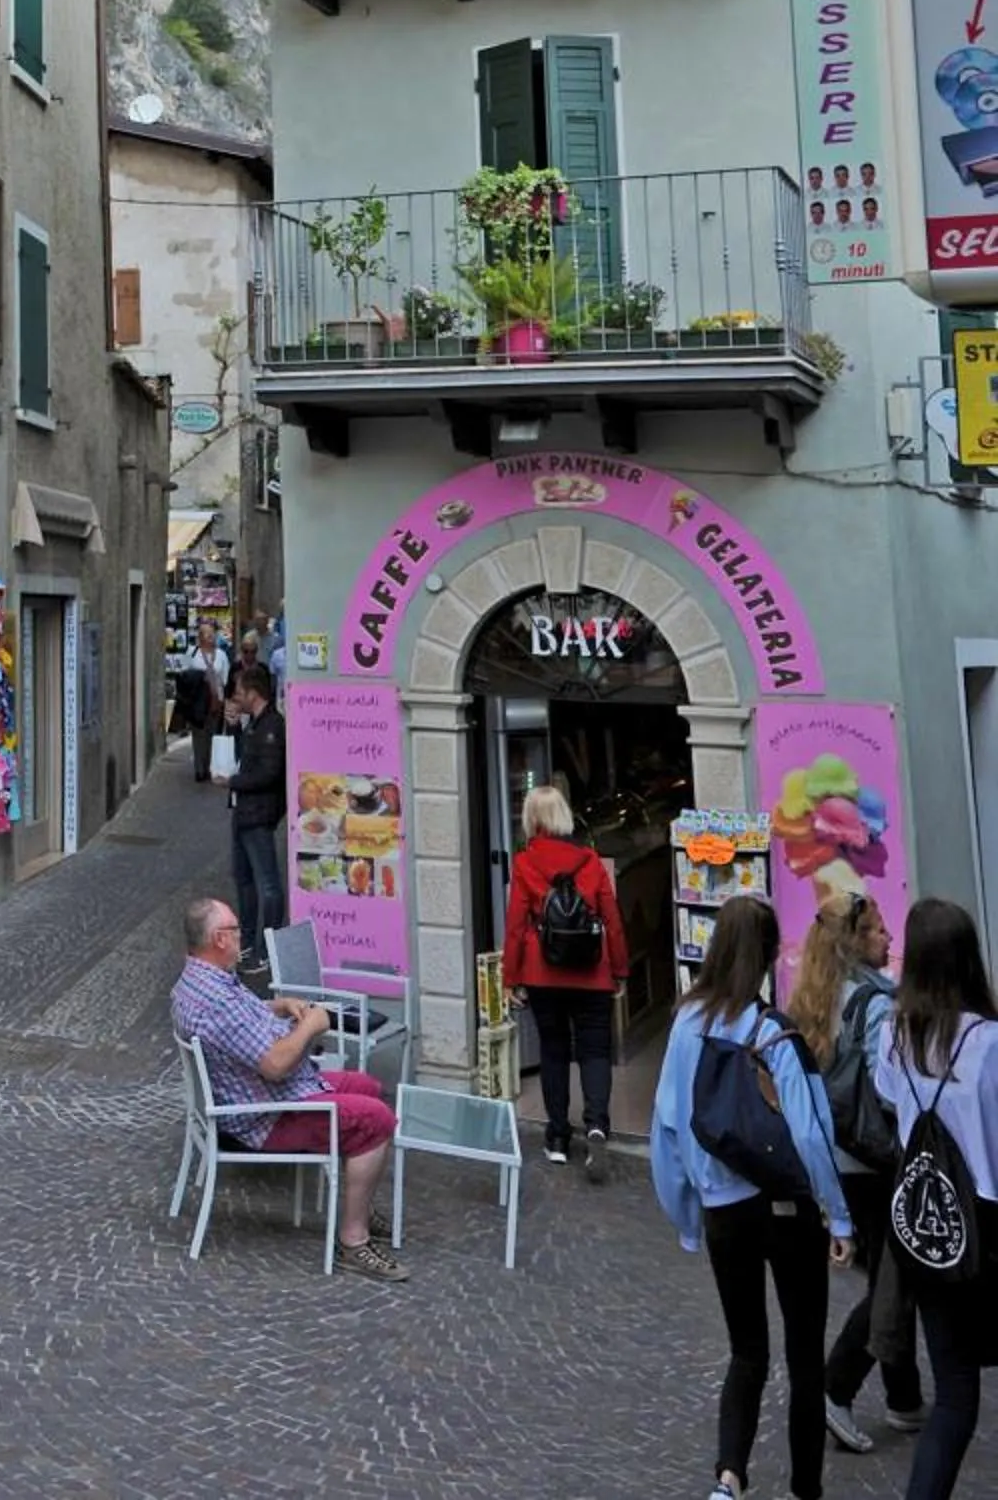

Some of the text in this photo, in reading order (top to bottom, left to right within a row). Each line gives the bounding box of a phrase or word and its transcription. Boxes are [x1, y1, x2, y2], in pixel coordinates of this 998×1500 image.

[847, 243, 867, 257] 10
[831, 263, 885, 279] minuti
[964, 343, 998, 363] ST
[495, 454, 644, 485] PINK PANTHER
[353, 529, 430, 668] CAFFÈ
[696, 523, 802, 689] GELATERIA
[531, 615, 624, 658] BAR
